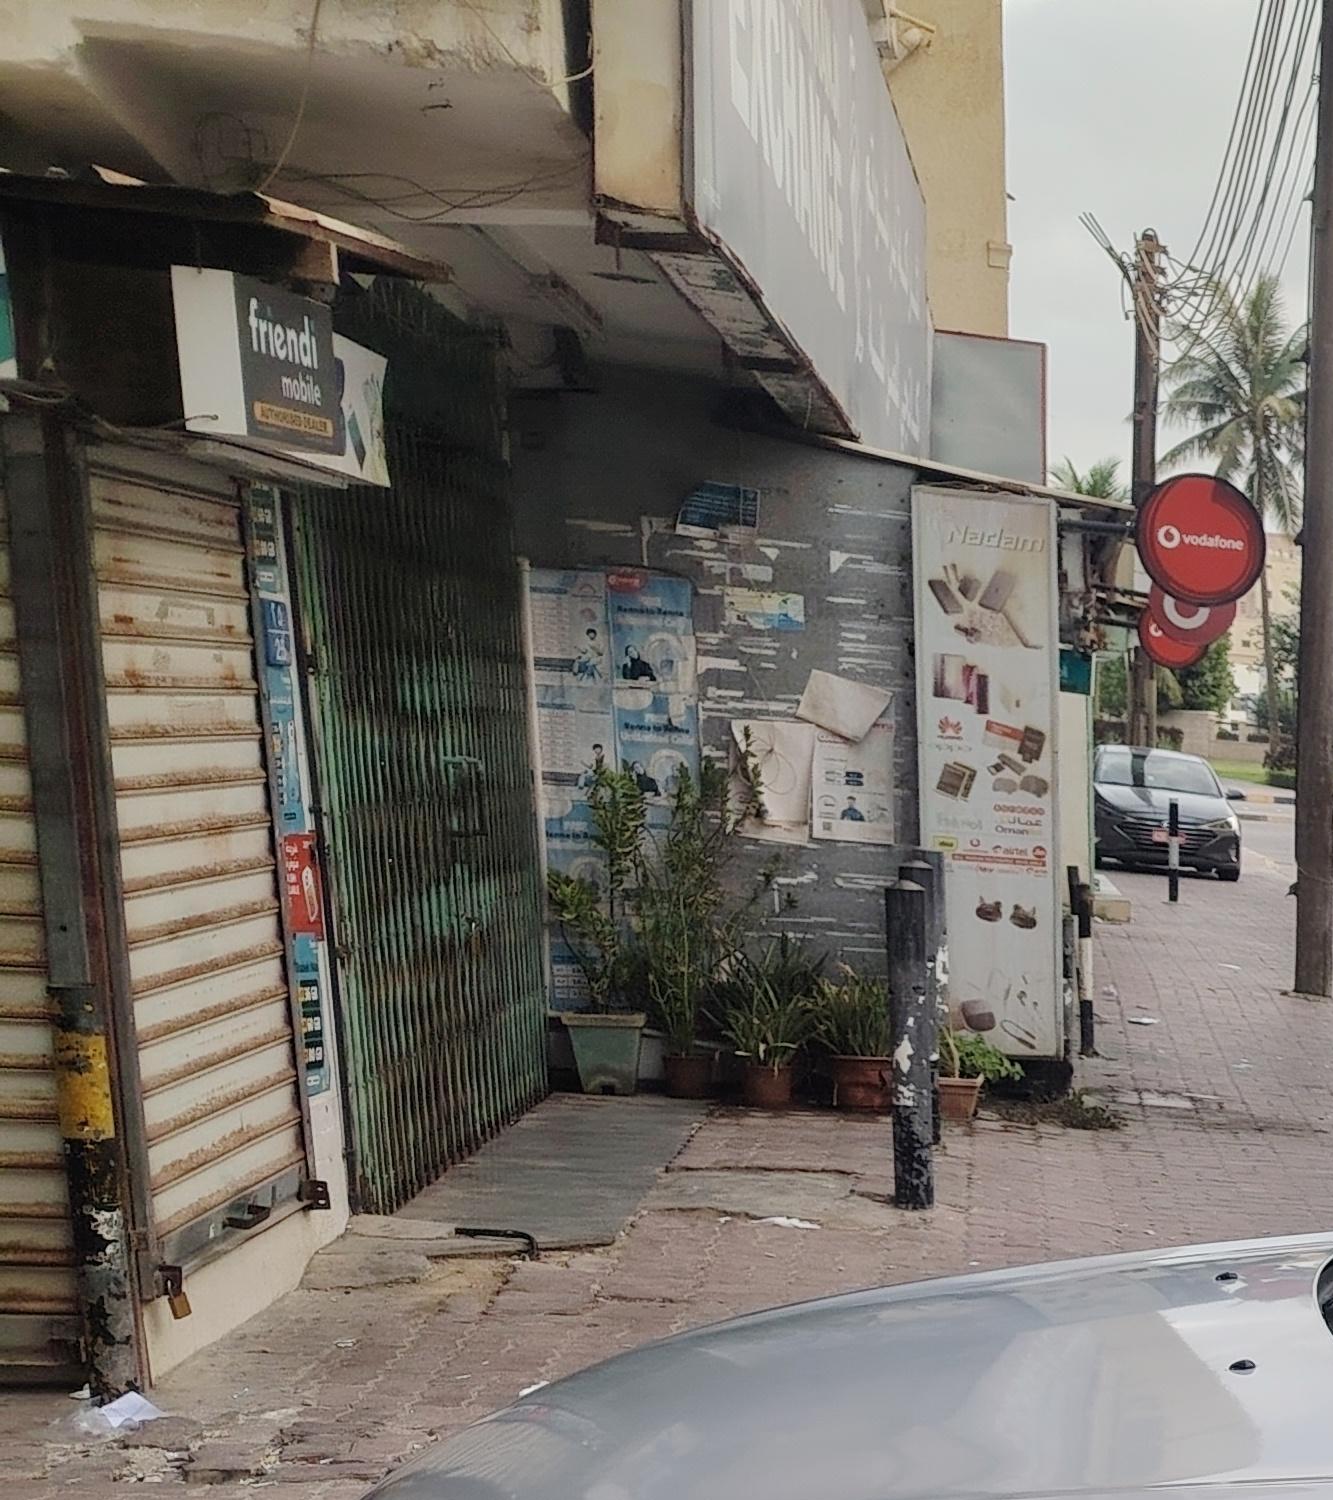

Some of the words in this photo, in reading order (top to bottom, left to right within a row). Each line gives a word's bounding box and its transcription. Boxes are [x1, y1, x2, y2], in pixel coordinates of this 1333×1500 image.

[249, 297, 319, 370] friendi
[281, 372, 322, 407] mobile
[1182, 533, 1246, 552] vodafone
